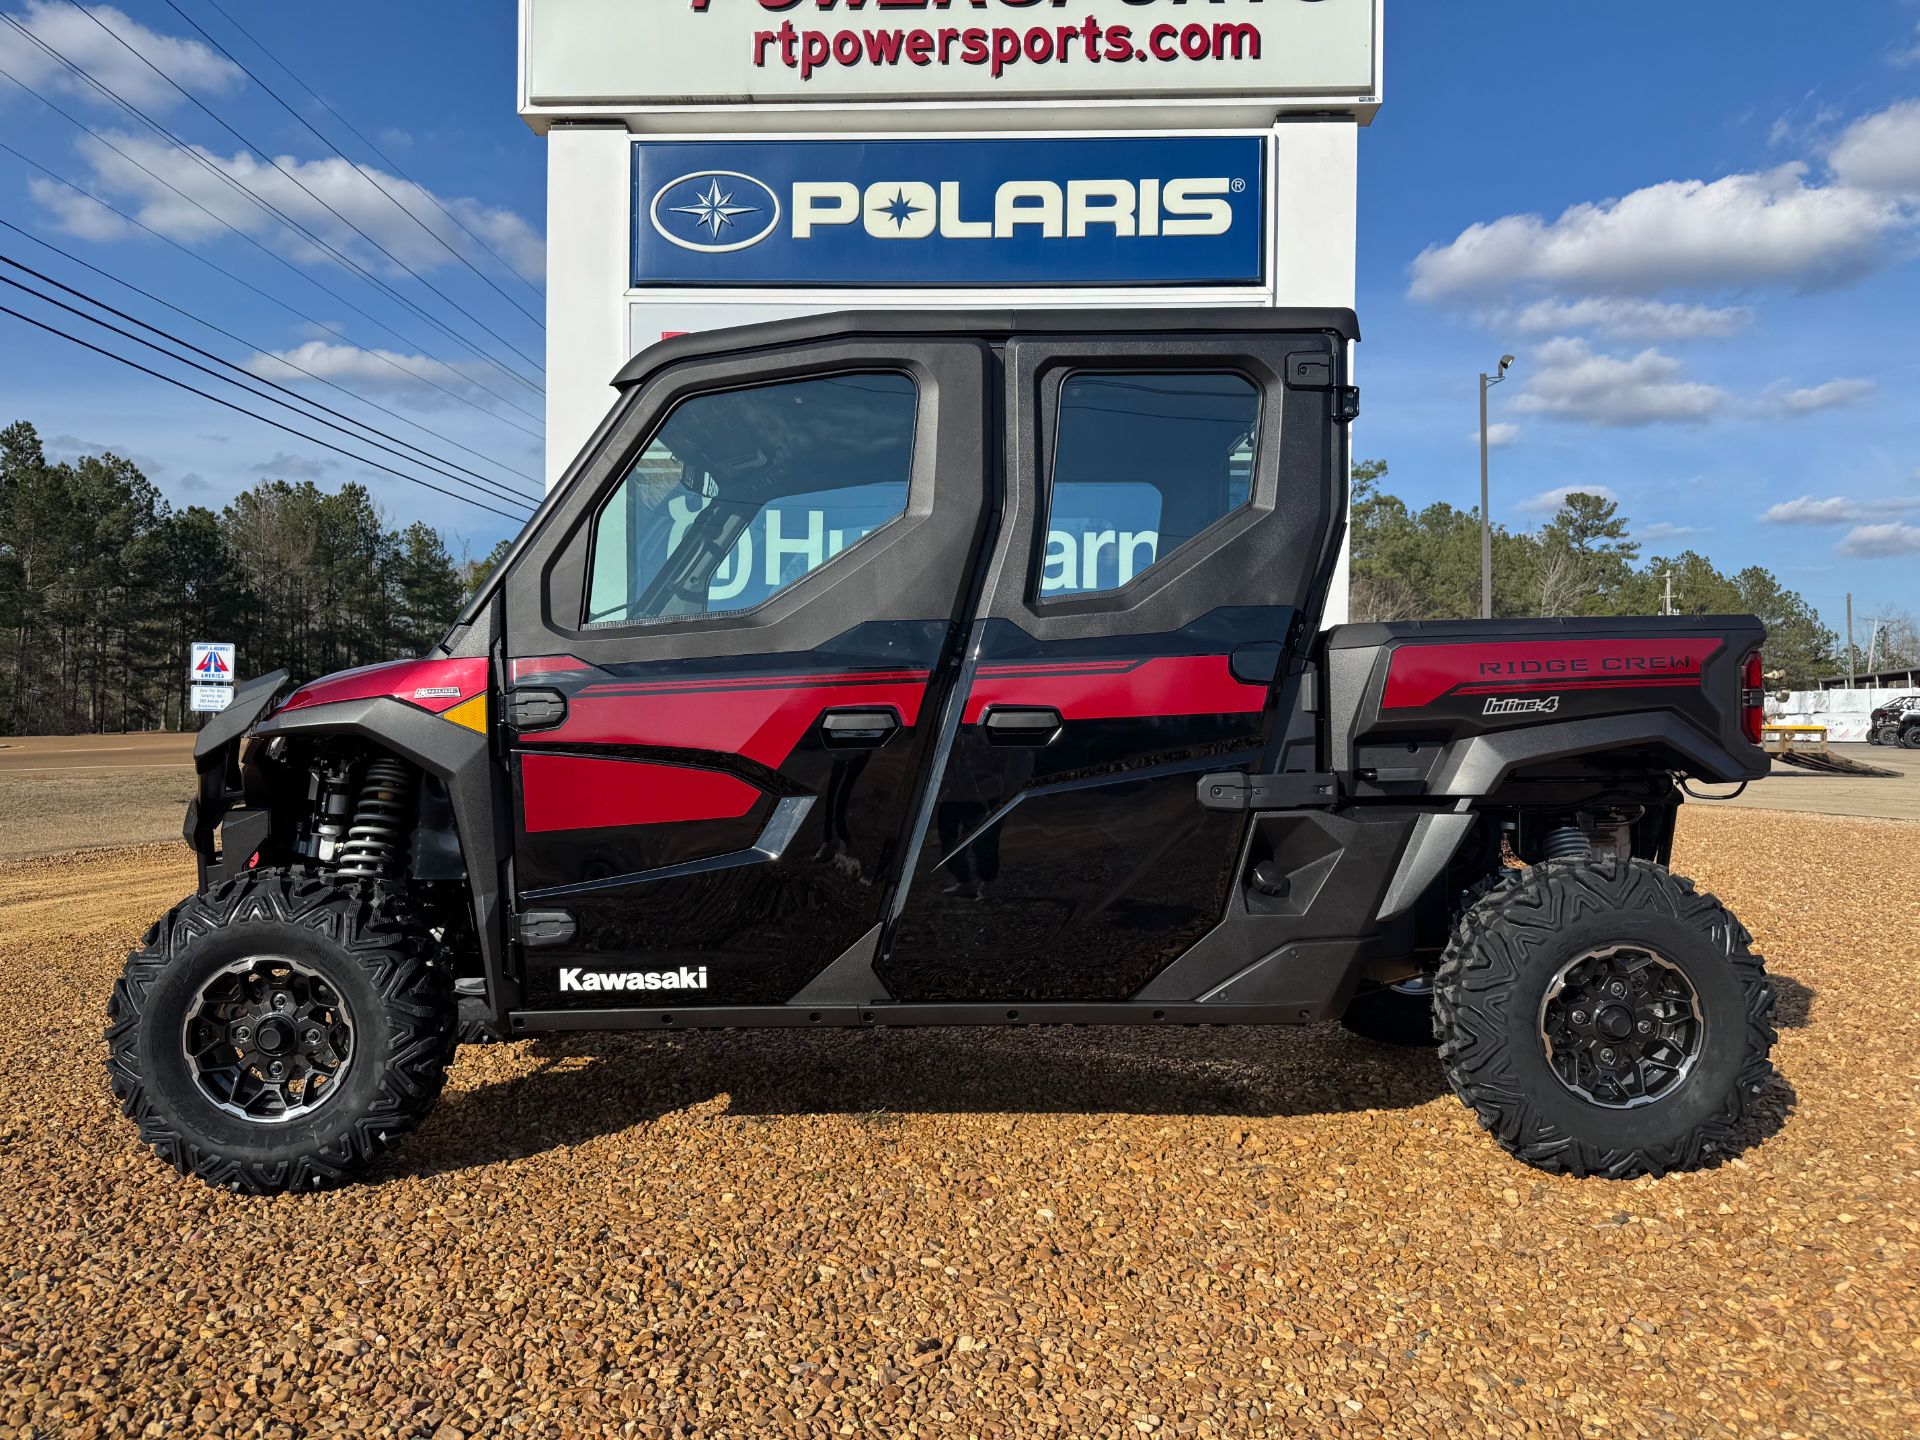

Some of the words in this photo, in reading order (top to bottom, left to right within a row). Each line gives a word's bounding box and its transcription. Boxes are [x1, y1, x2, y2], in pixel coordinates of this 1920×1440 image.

[753, 15, 1261, 81] rtpowersports.com
[791, 177, 1231, 240] POLARIS
[1479, 659, 1590, 676] RIDGE
[1601, 655, 1691, 672] CREW
[1482, 696, 1560, 715] Inline-4
[559, 966, 708, 992] Kawasaki
